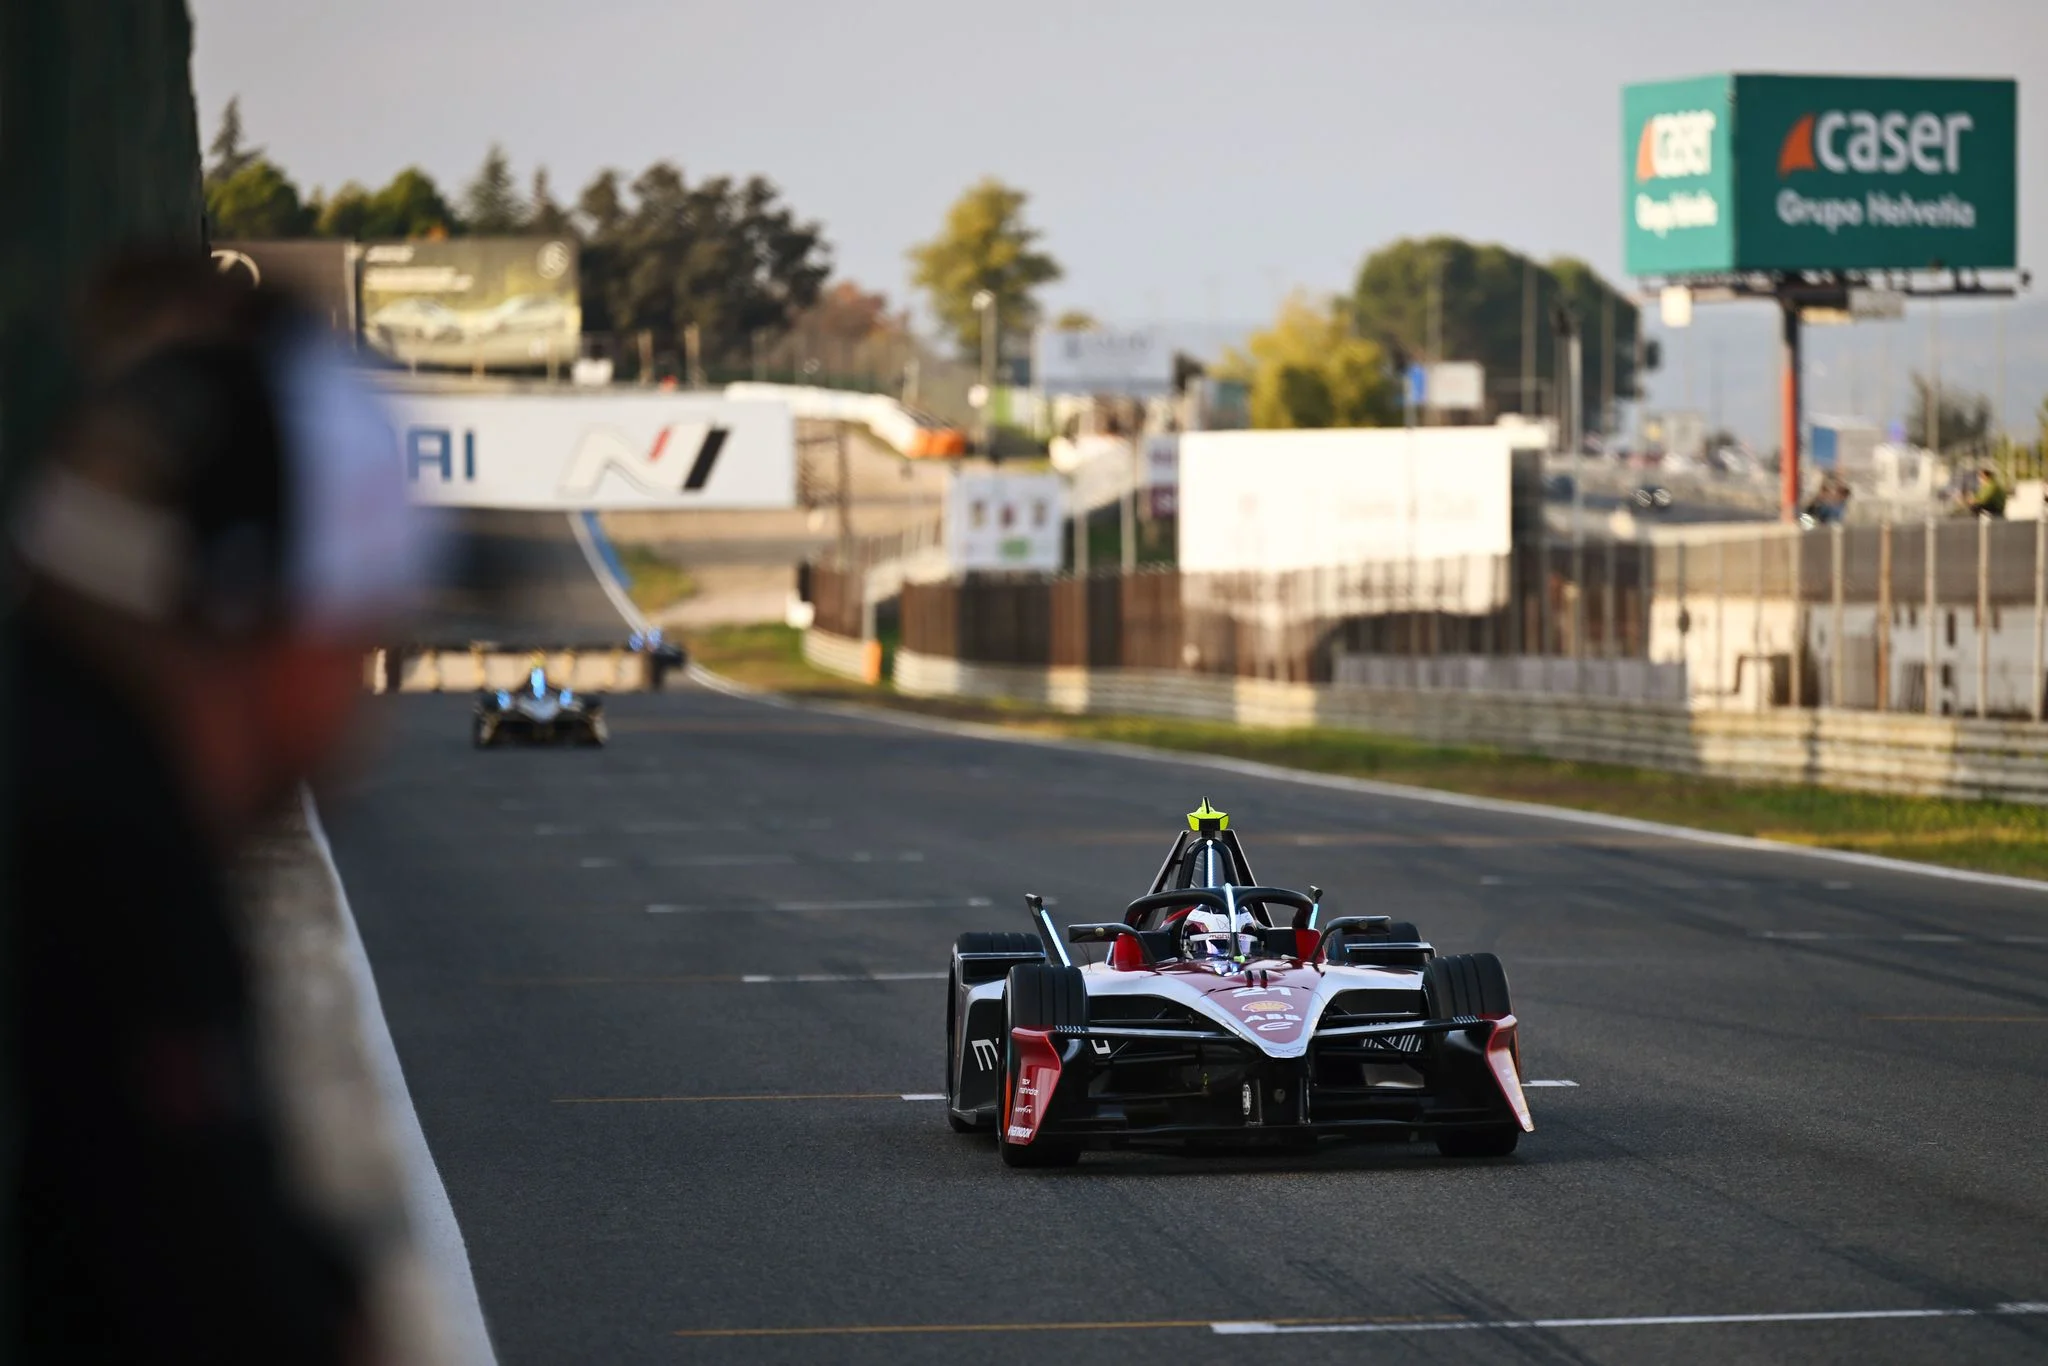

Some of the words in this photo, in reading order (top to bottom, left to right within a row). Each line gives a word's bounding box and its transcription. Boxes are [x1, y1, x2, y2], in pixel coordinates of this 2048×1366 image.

[1816, 110, 1974, 174] caser
[1776, 188, 1863, 233] Grupo
[1867, 189, 1976, 228] Helvetia
